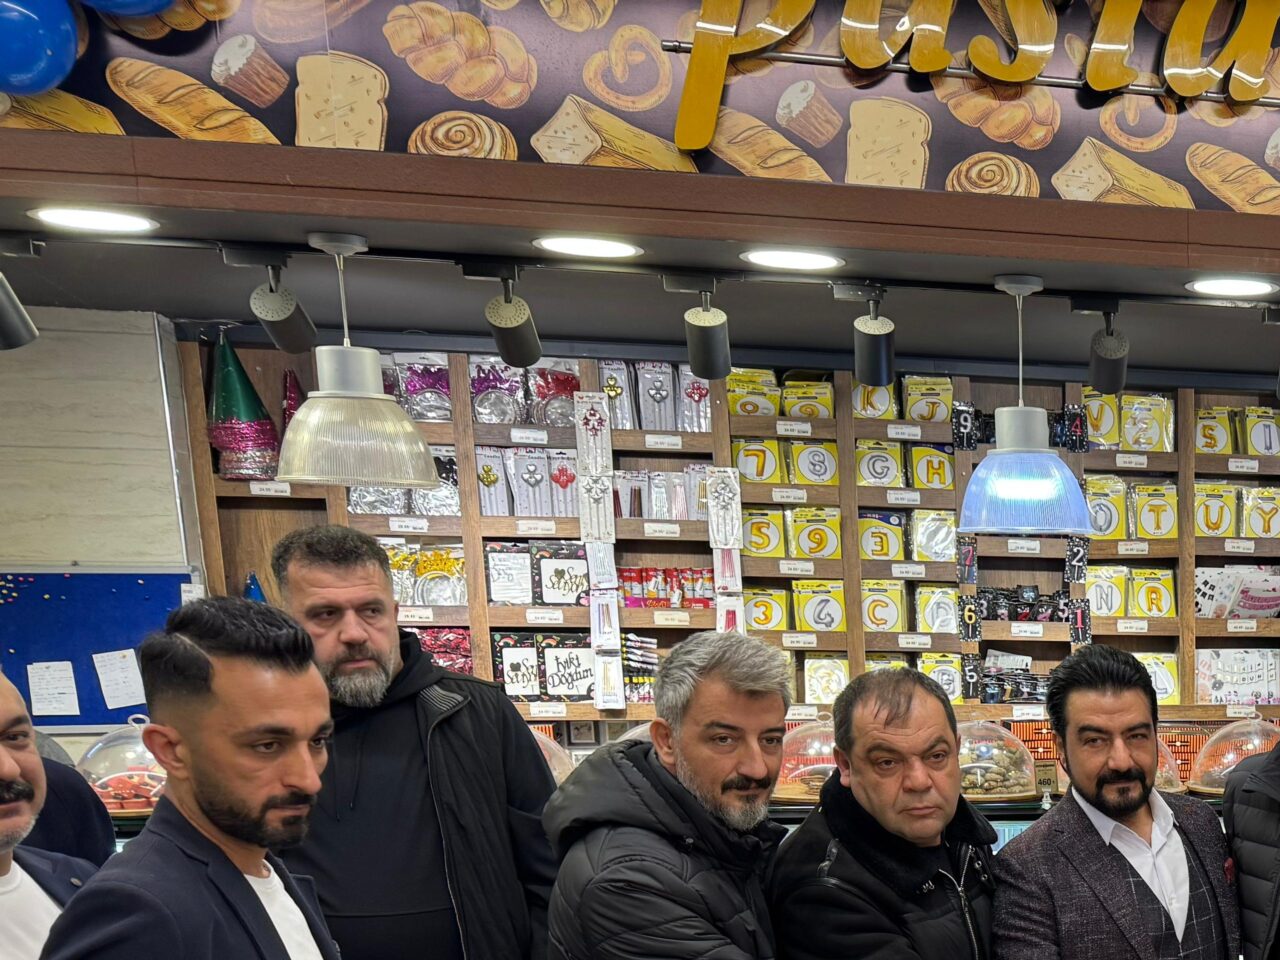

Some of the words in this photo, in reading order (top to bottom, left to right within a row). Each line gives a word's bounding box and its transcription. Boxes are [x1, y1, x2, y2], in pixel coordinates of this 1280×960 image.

[959, 413, 972, 433] 9
[1071, 416, 1082, 436] 4
[742, 449, 766, 477] 7
[807, 450, 828, 477] 8
[867, 455, 890, 479] G
[926, 458, 946, 485] H
[1147, 504, 1168, 531] T
[1203, 503, 1225, 532] U
[1256, 506, 1278, 534] Y
[751, 521, 770, 549] 5
[807, 527, 828, 554] 9
[1071, 546, 1084, 567] 2
[1058, 599, 1069, 619] 5
[1095, 584, 1114, 613] N
[1146, 585, 1163, 613] R
[753, 600, 774, 625] 3
[813, 598, 835, 628] 4
[867, 599, 889, 627] C
[964, 605, 976, 624] 6
[1075, 608, 1085, 629] 1
[964, 665, 978, 684] 5
